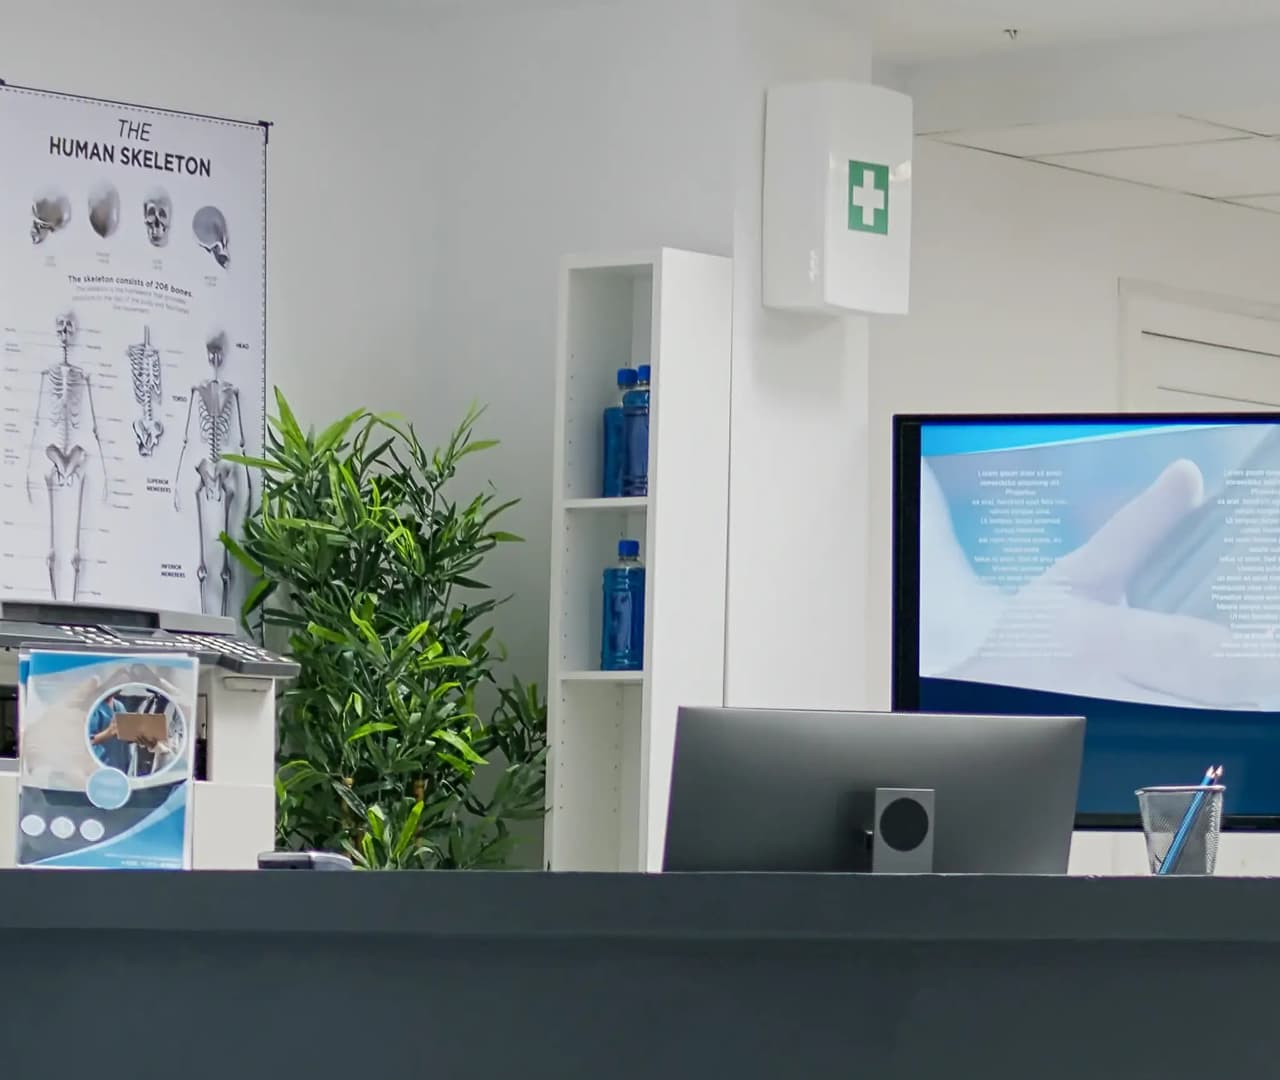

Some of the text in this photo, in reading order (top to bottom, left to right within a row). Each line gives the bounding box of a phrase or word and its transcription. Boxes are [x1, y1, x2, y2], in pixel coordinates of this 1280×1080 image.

[118, 119, 153, 142] THE
[49, 136, 211, 177] HUMAN SKELETON
[68, 275, 82, 284] The
[83, 276, 115, 284] skeleton
[116, 277, 145, 287] consists
[145, 280, 154, 289] of
[155, 281, 169, 292] 206
